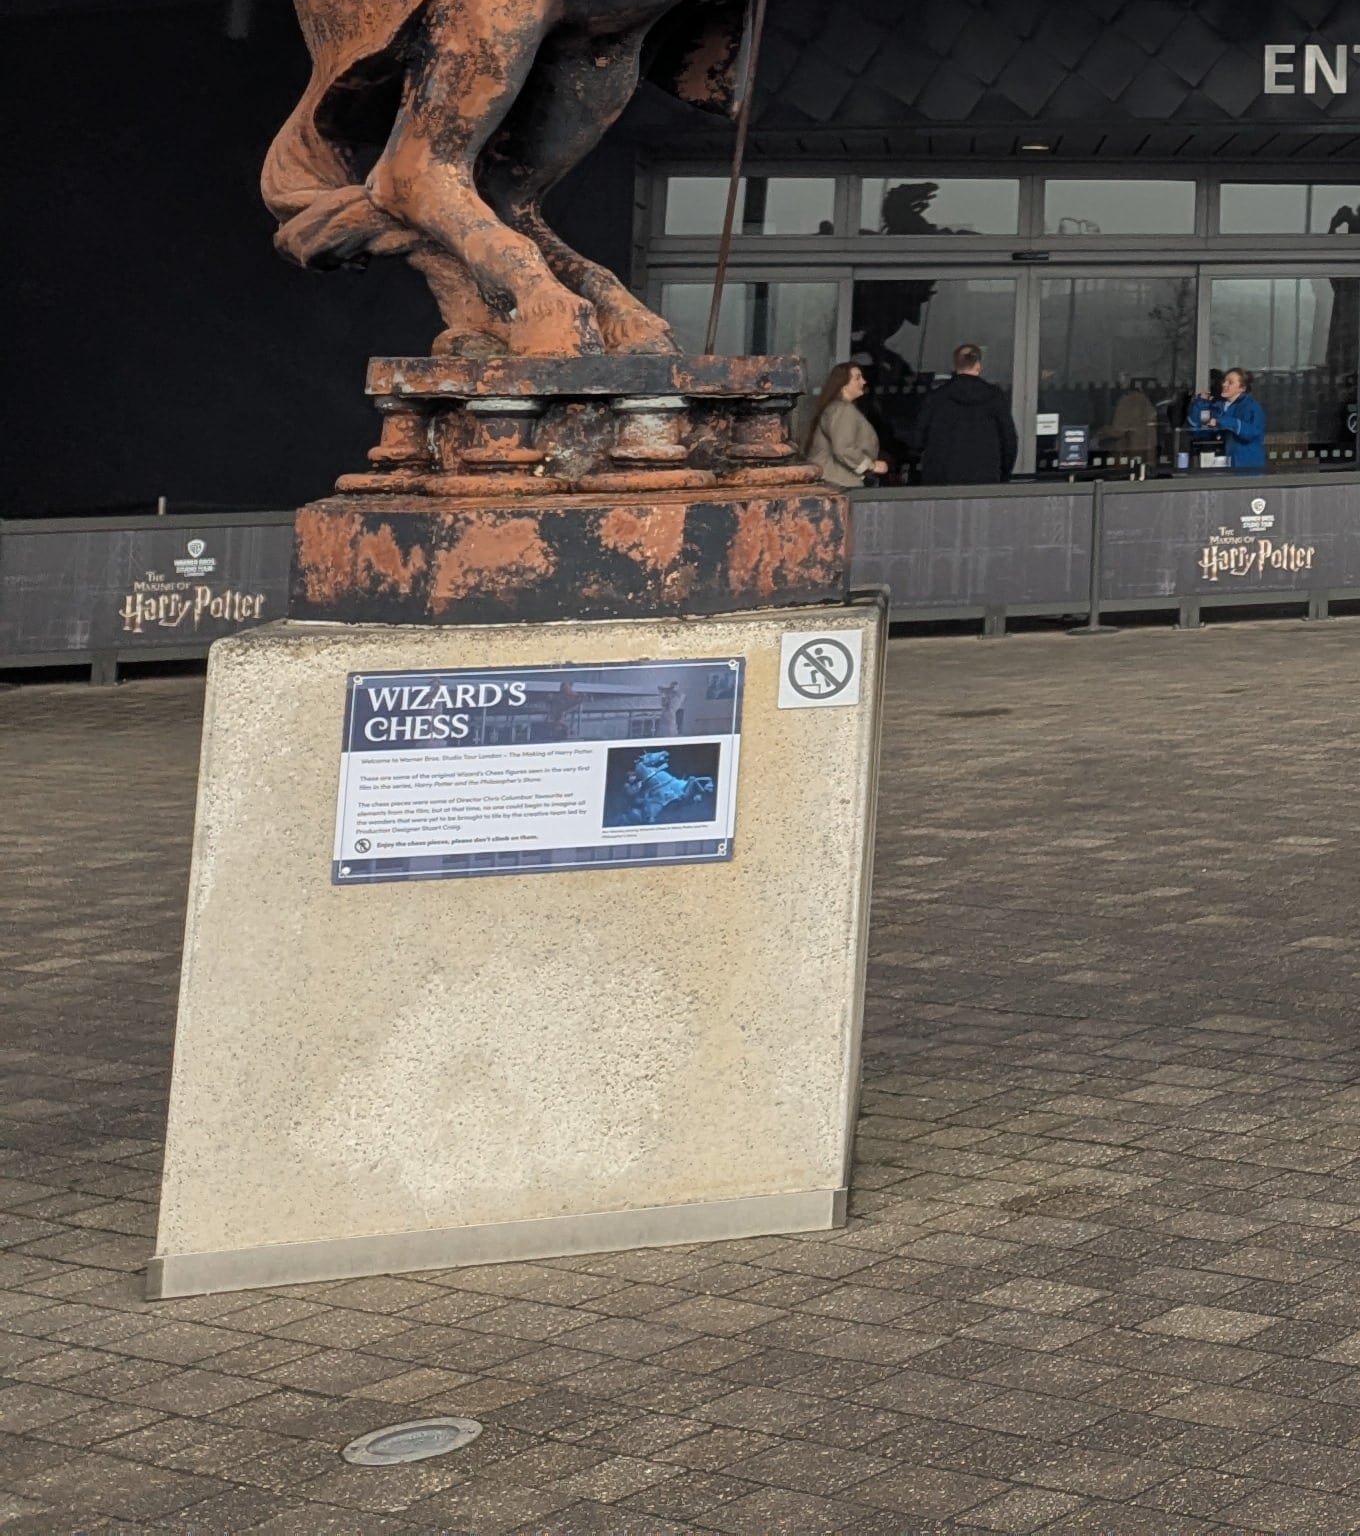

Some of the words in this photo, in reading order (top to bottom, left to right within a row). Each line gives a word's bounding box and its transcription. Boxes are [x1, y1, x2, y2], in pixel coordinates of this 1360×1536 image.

[1198, 546, 1256, 581] Harry
[1258, 540, 1315, 580] Potter
[118, 593, 192, 633] Harry
[194, 586, 266, 632] Potter
[368, 682, 526, 712] WIZARD'S
[364, 714, 469, 742] CHESS
